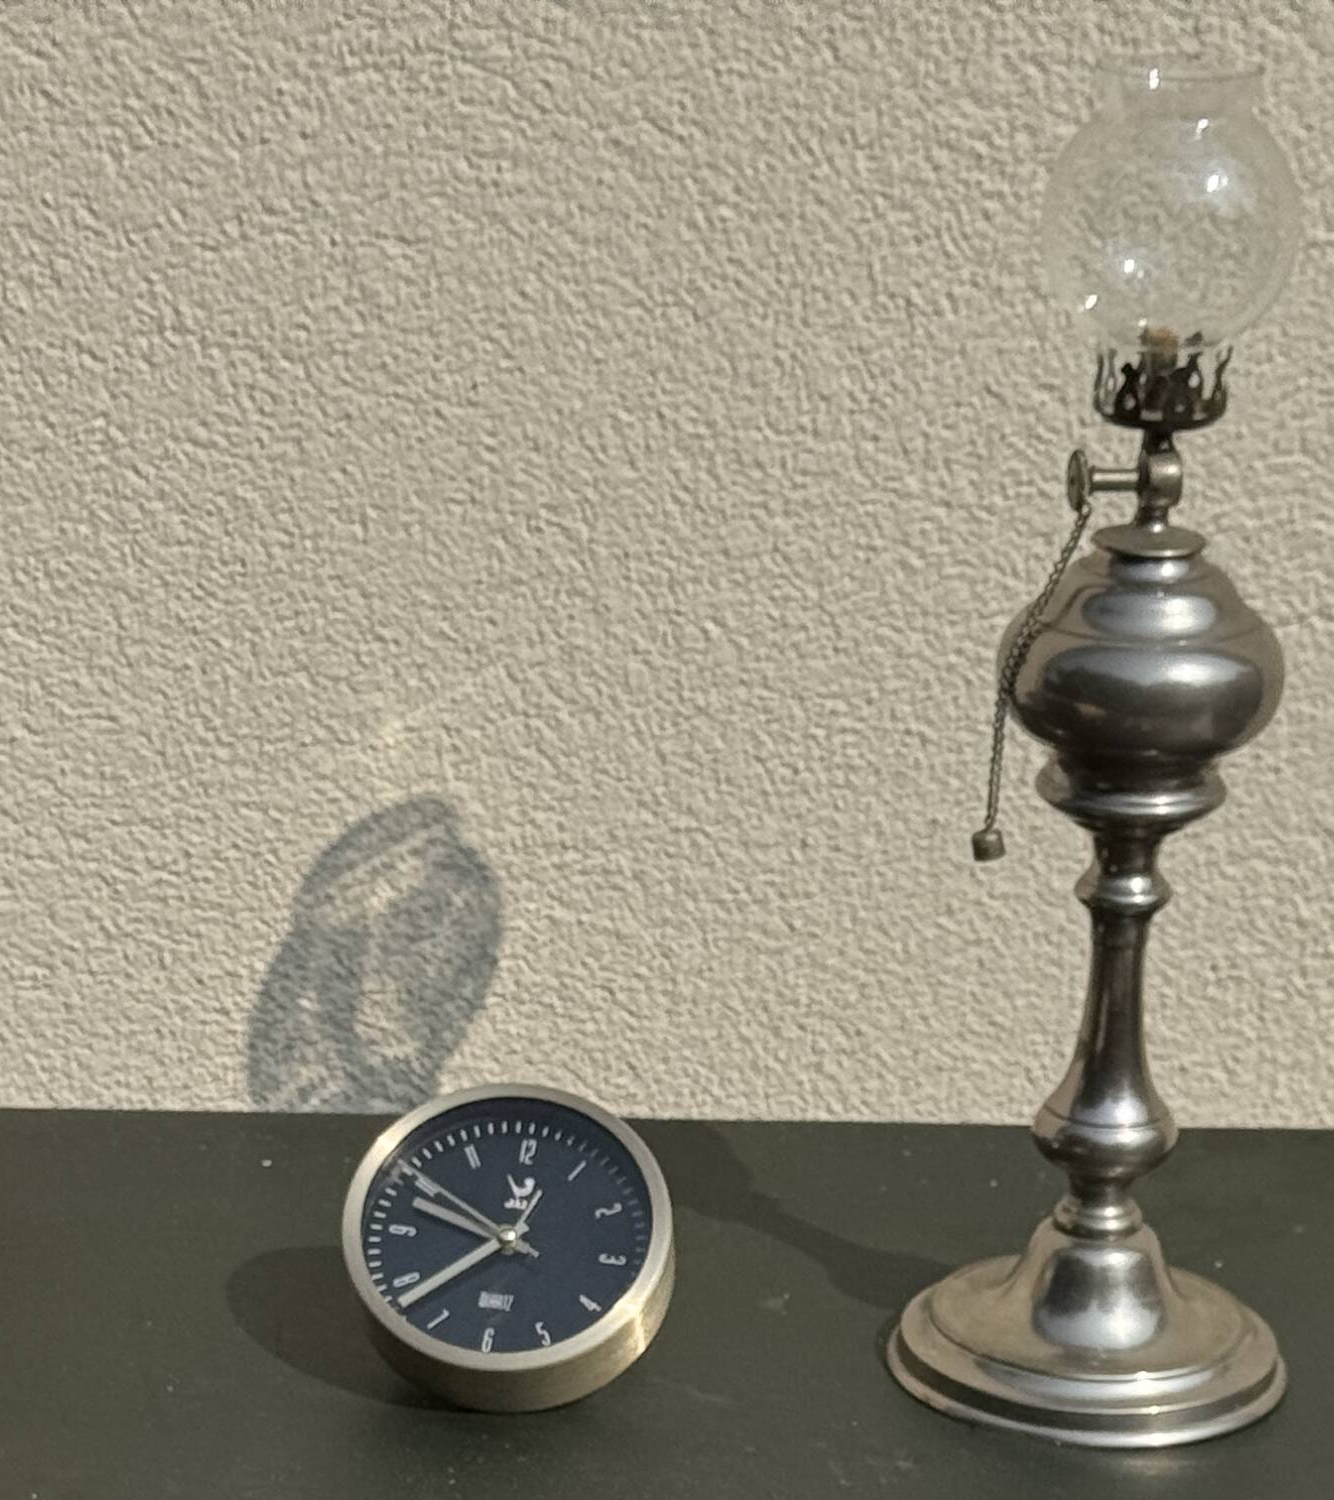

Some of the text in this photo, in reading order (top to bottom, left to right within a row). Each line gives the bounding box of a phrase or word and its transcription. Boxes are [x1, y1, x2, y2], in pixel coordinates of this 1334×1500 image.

[519, 1139, 537, 1165] 12
[568, 1160, 587, 1182] 1
[595, 1202, 622, 1219] 2
[388, 1224, 417, 1237] 9
[598, 1253, 627, 1266] 3
[393, 1272, 420, 1287] 8
[579, 1294, 602, 1312] 4
[427, 1308, 450, 1330] 7
[481, 1328, 495, 1353] 6
[535, 1322, 551, 1346] 5
